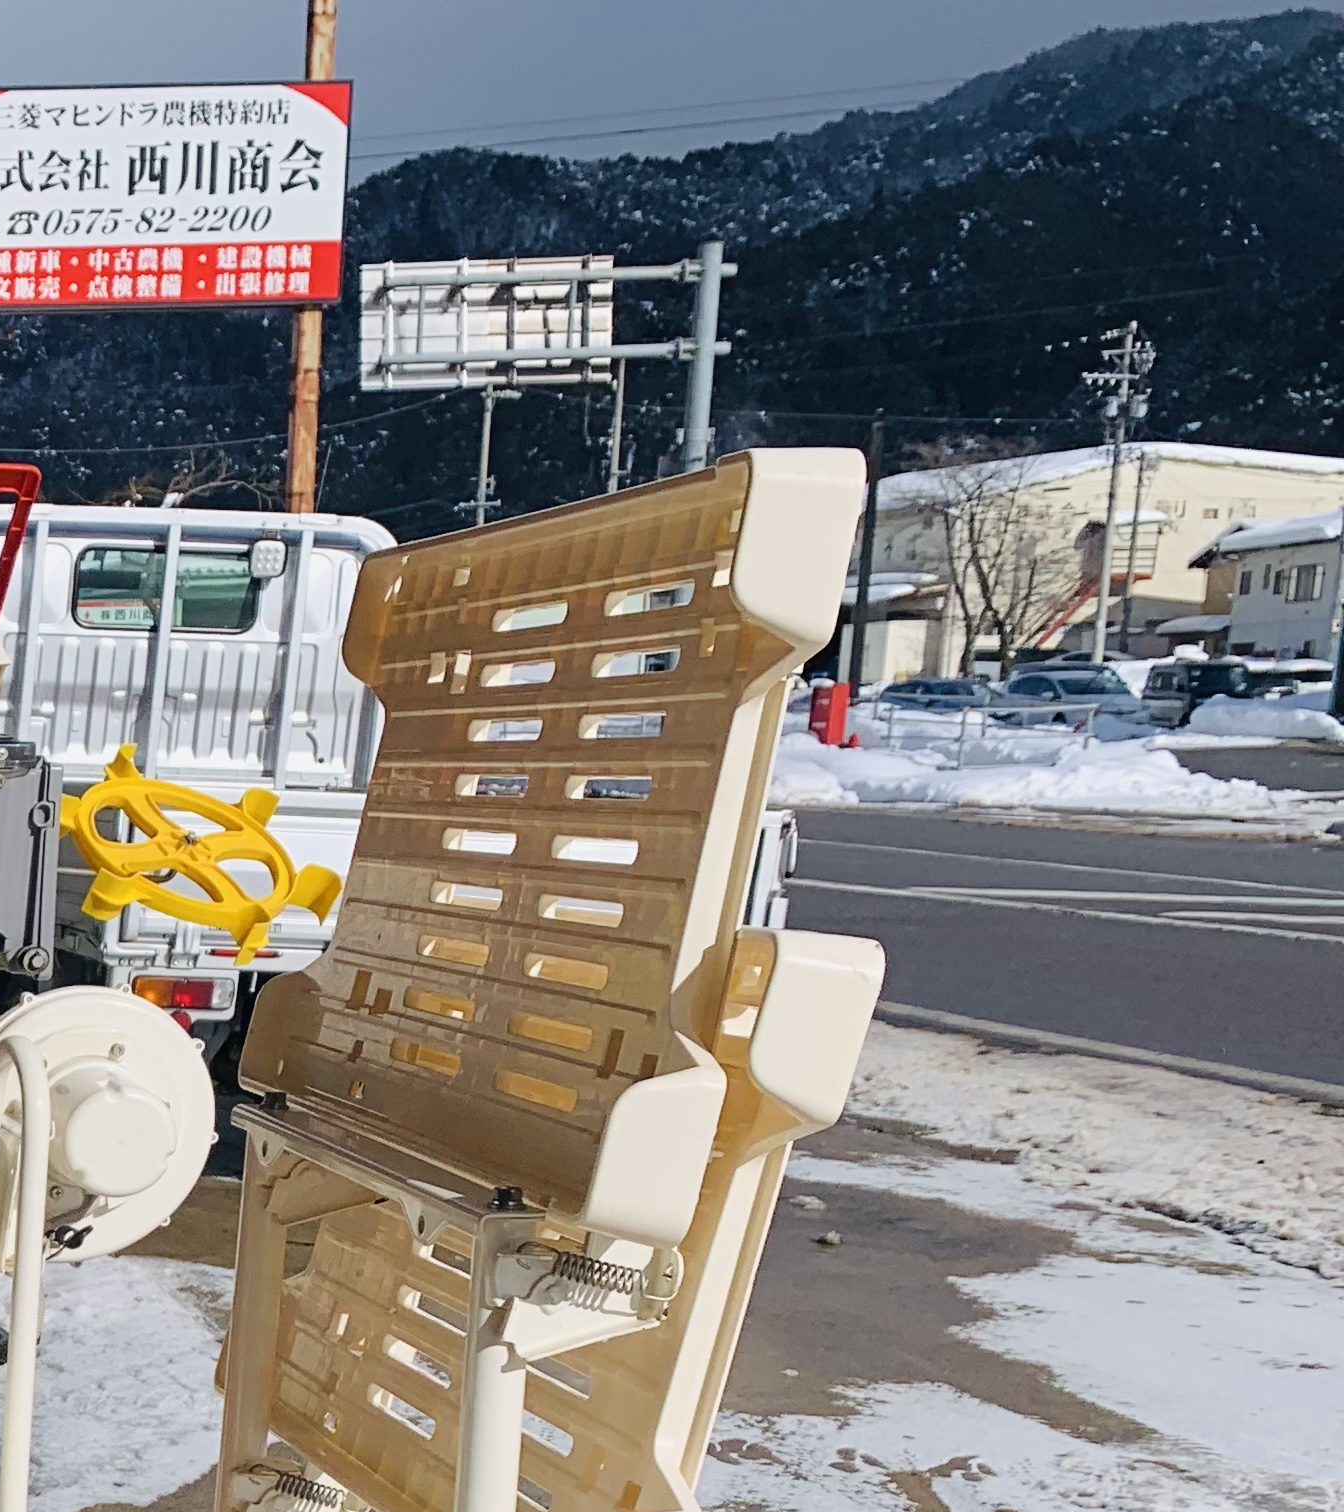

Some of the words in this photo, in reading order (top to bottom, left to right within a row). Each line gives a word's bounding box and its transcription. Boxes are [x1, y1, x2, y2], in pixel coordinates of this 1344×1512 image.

[126, 138, 324, 196] 西川商会
[43, 204, 272, 236] 0575-82-2200
